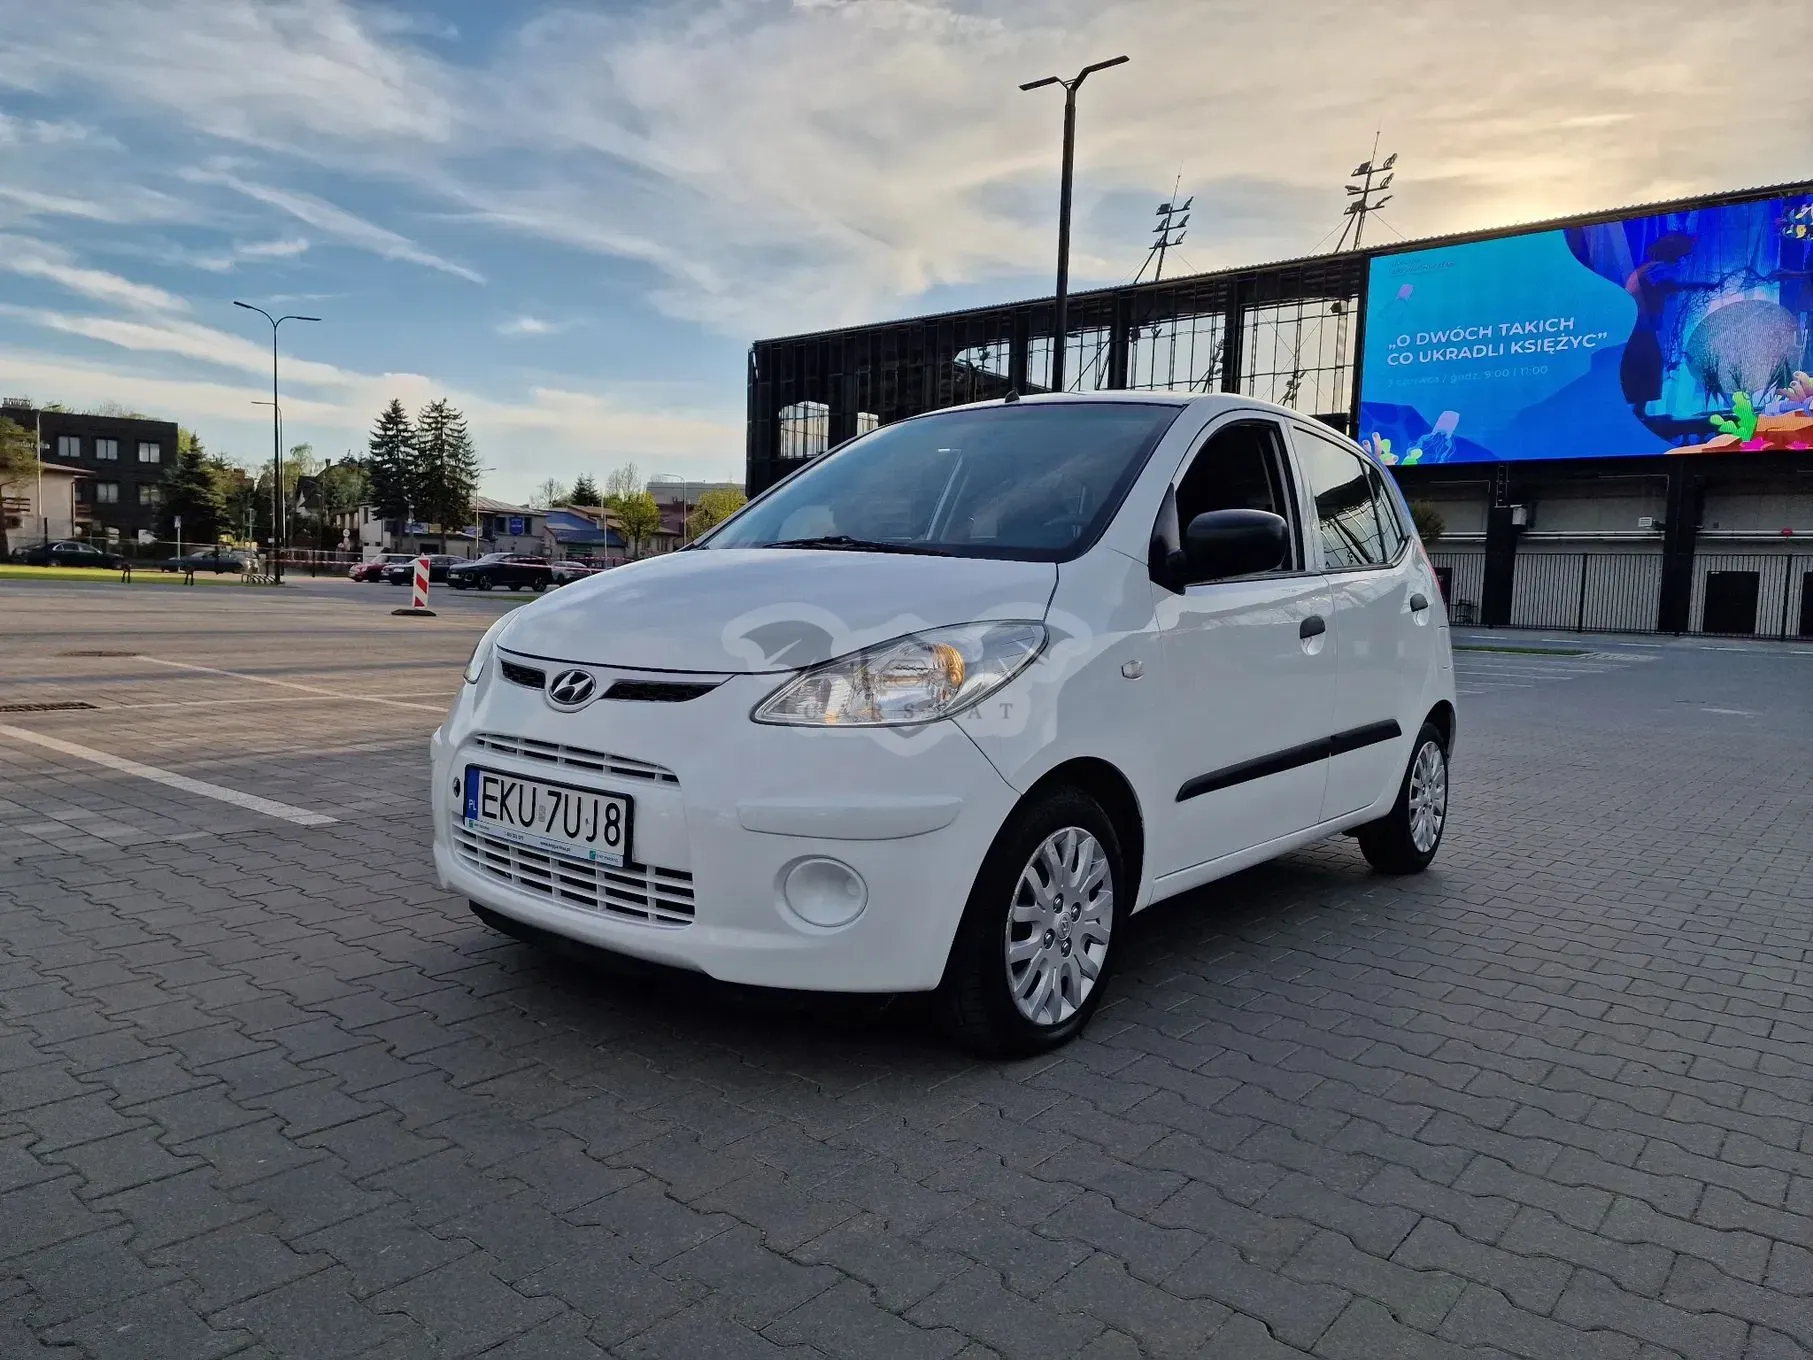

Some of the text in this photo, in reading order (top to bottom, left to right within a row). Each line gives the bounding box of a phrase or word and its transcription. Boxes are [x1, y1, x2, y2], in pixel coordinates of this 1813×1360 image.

[1416, 325, 1493, 345] DWÓCH
[1499, 316, 1575, 336] TAKICH
[1387, 352, 1414, 366] CO
[1420, 343, 1504, 363] UKRADLI
[482, 775, 621, 847] EKU 7UJ8
